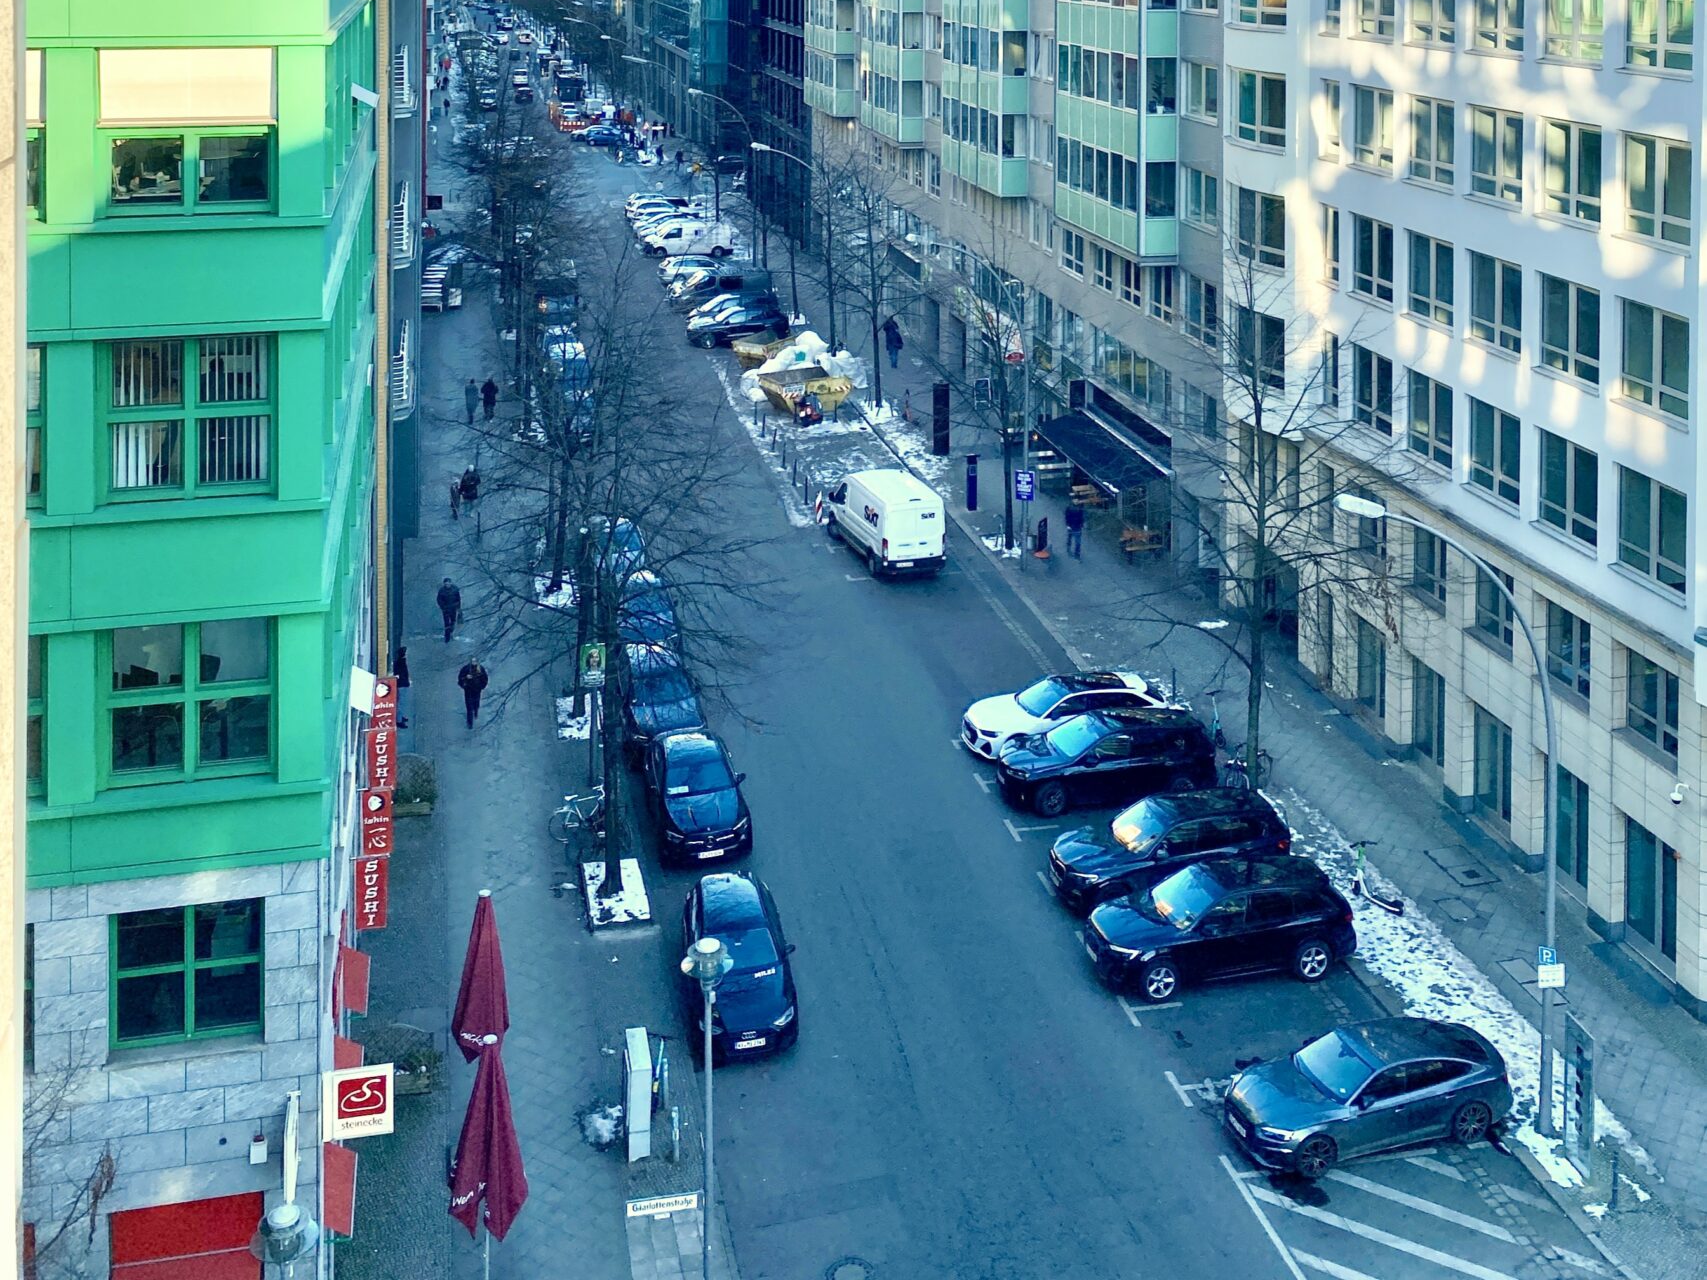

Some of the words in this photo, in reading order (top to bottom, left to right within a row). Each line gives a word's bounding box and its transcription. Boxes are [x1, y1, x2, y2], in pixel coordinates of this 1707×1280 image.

[375, 732, 389, 786] SUSHI
[363, 860, 379, 926] SUSHI
[341, 1117, 383, 1130] steinecke
